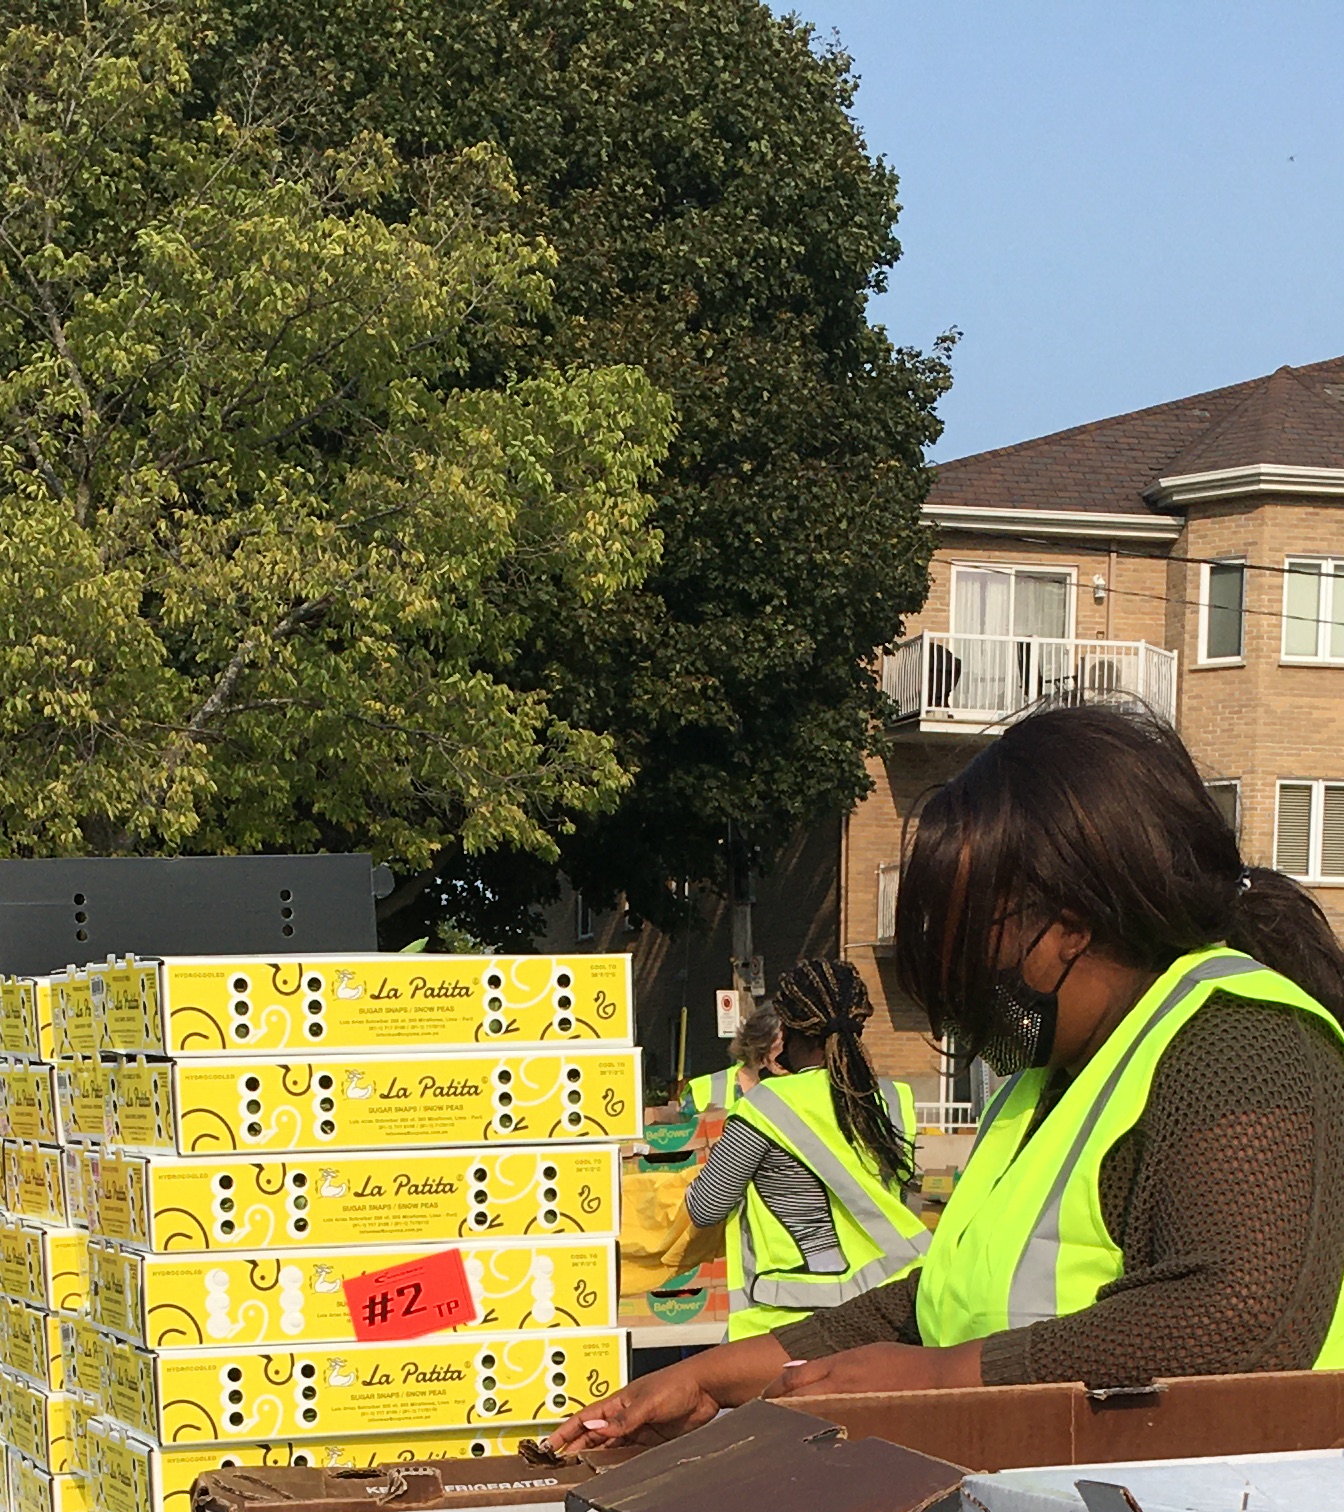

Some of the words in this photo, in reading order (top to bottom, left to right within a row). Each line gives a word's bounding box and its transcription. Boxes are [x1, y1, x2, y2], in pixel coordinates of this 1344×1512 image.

[370, 978, 403, 1000] La
[409, 977, 477, 999] Patita
[379, 1077, 412, 1099] La
[419, 1076, 486, 1098] Patita
[353, 1176, 386, 1197] La
[393, 1174, 460, 1196] Patita
[362, 1282, 427, 1327] #2
[433, 1299, 460, 1318] TP
[362, 1364, 394, 1386] La
[401, 1362, 468, 1384] Patita
[444, 1478, 559, 1493] FRIGERATED
